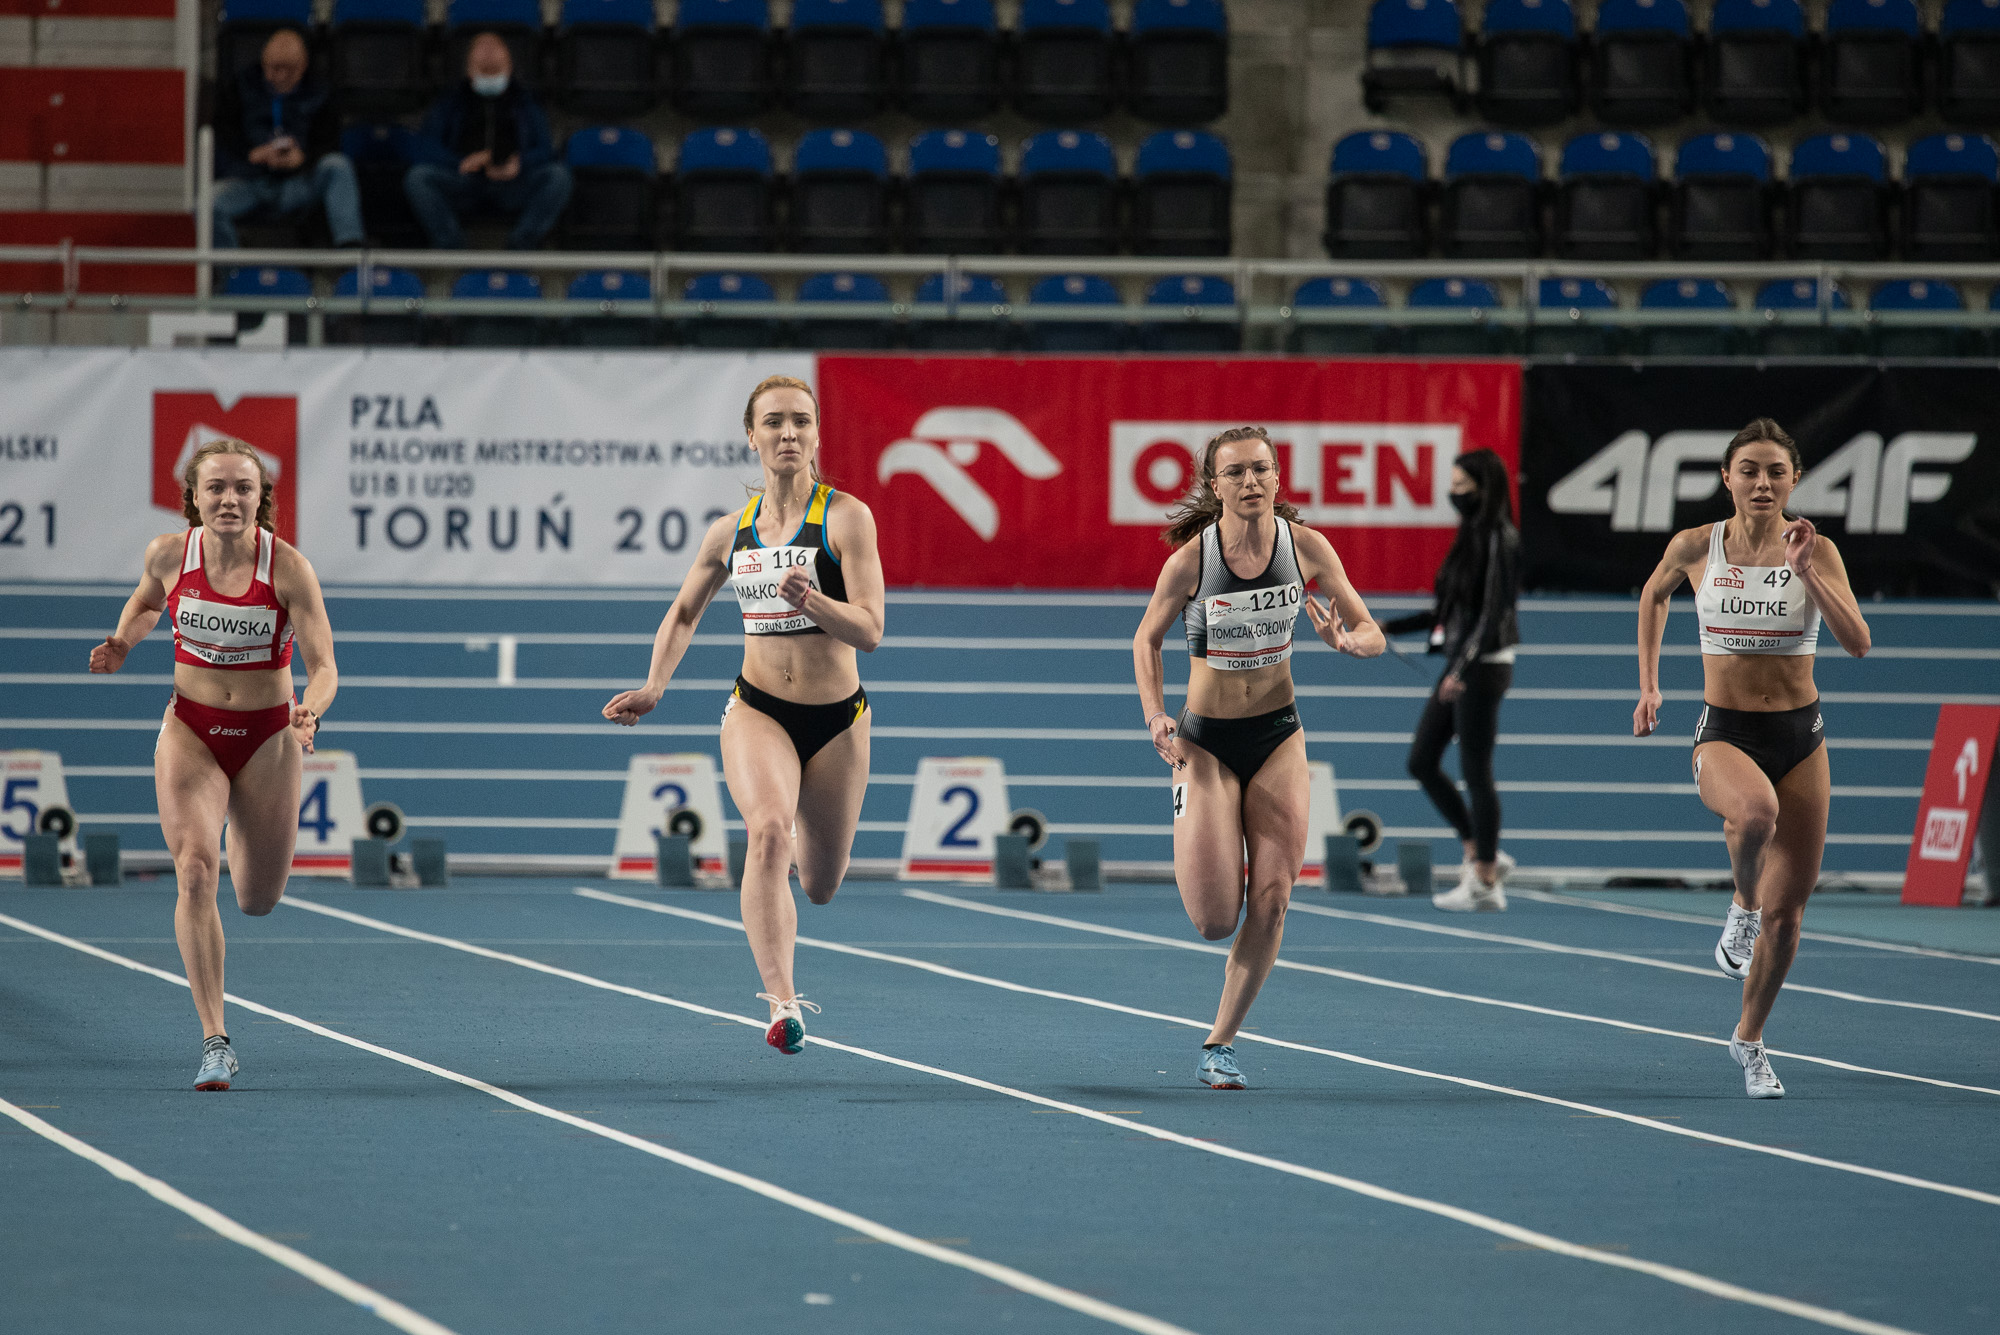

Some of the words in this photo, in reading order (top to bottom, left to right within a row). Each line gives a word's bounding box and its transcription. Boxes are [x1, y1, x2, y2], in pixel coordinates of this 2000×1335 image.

[351, 396, 442, 430] PZLA
[0, 436, 57, 461] LSKI
[350, 438, 466, 465] HALOWE
[474, 439, 663, 466] MISTRZOSTWA
[350, 472, 398, 498] U18
[423, 472, 475, 498] U20
[1131, 439, 1436, 507] OLEN
[352, 493, 573, 551] TORUŃ
[772, 549, 807, 569] 116
[1715, 578, 1743, 588] ORLEN
[1763, 569, 1792, 588] 49
[1250, 586, 1299, 612] 1210
[1721, 596, 1788, 616] LÜDTKE
[180, 610, 271, 637] BELOWSKA
[755, 620, 782, 631] TORUŃ
[784, 617, 807, 630] 2021
[1723, 636, 1756, 647] TORUŃ
[1758, 639, 1781, 647] 2021
[228, 652, 250, 663] 2021
[1227, 657, 1259, 669] TORUŃ
[1262, 654, 1282, 665] 2021
[221, 728, 248, 736] asics
[1, 779, 39, 840] 5
[298, 778, 336, 843] 4
[940, 785, 980, 847] 2
